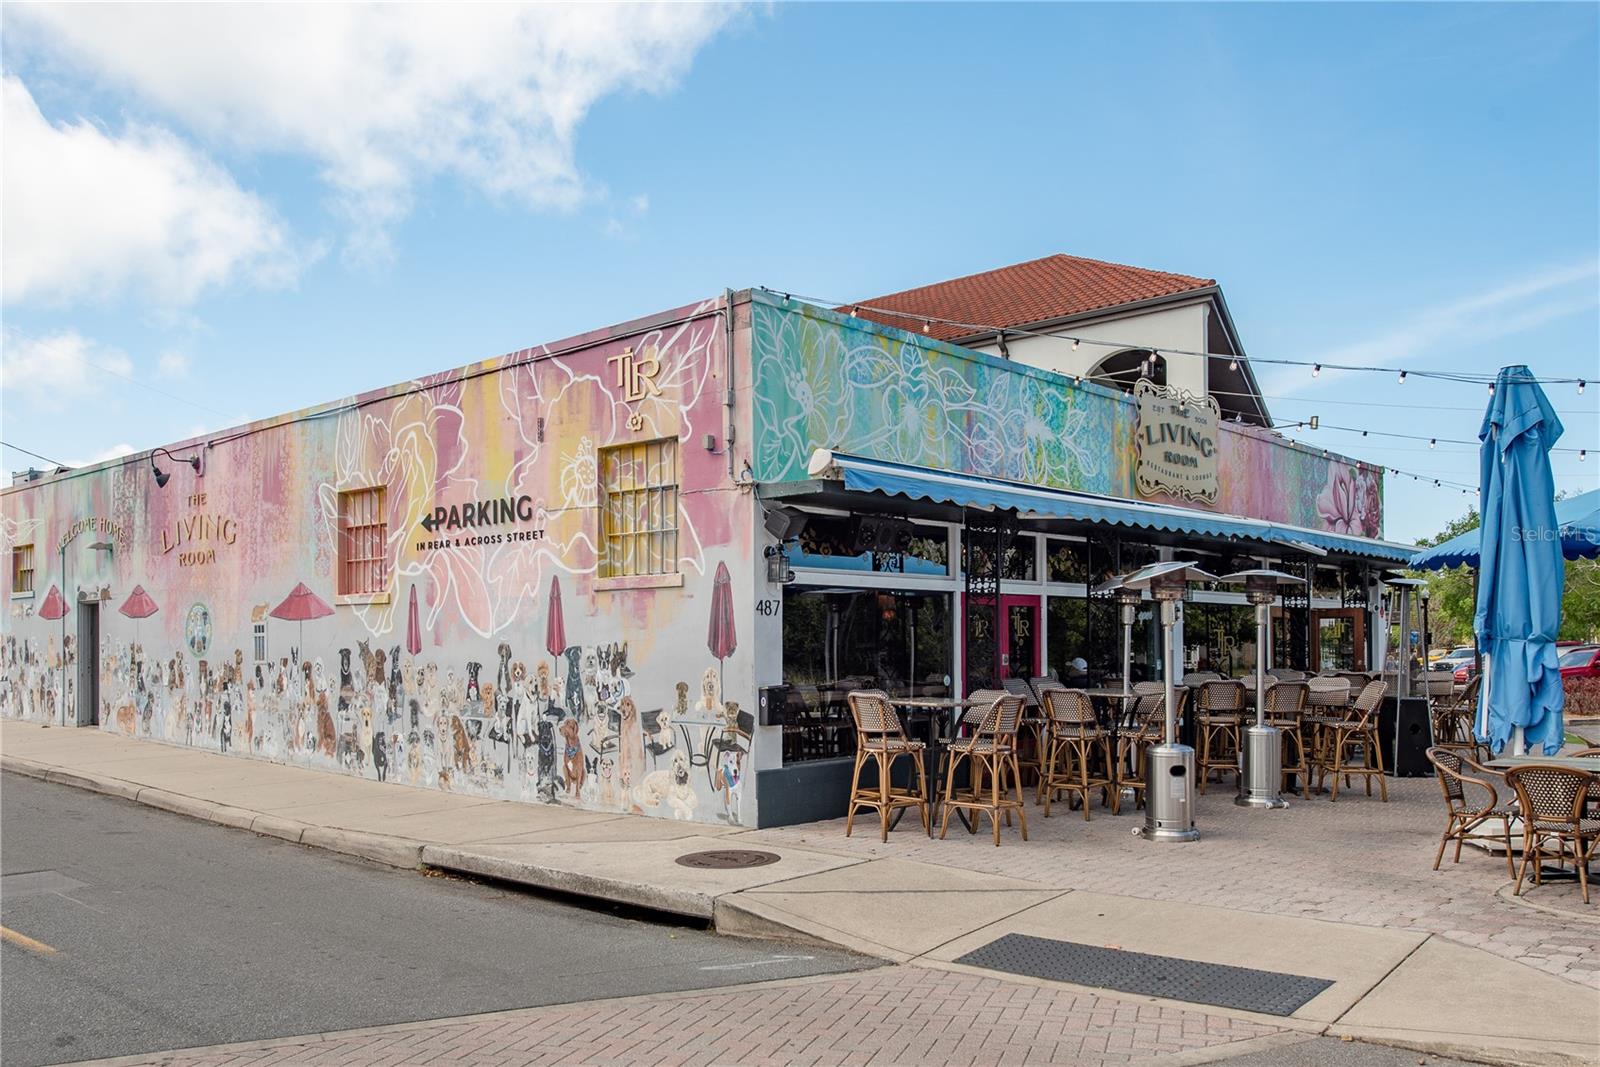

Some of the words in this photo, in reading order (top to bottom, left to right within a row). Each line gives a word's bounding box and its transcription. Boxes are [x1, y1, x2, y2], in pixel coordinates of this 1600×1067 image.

[1145, 423, 1213, 458] LIVING
[1164, 451, 1198, 469] ROOM
[188, 493, 207, 508] THE
[434, 495, 533, 531] PARKING
[160, 514, 237, 555] LIVING
[416, 542, 426, 551] IN
[427, 539, 451, 551] REAR
[455, 538, 461, 547] &
[464, 534, 502, 547] ACROSS
[506, 529, 545, 543] STREET
[179, 549, 216, 567] ROOM
[756, 599, 780, 616] 487
